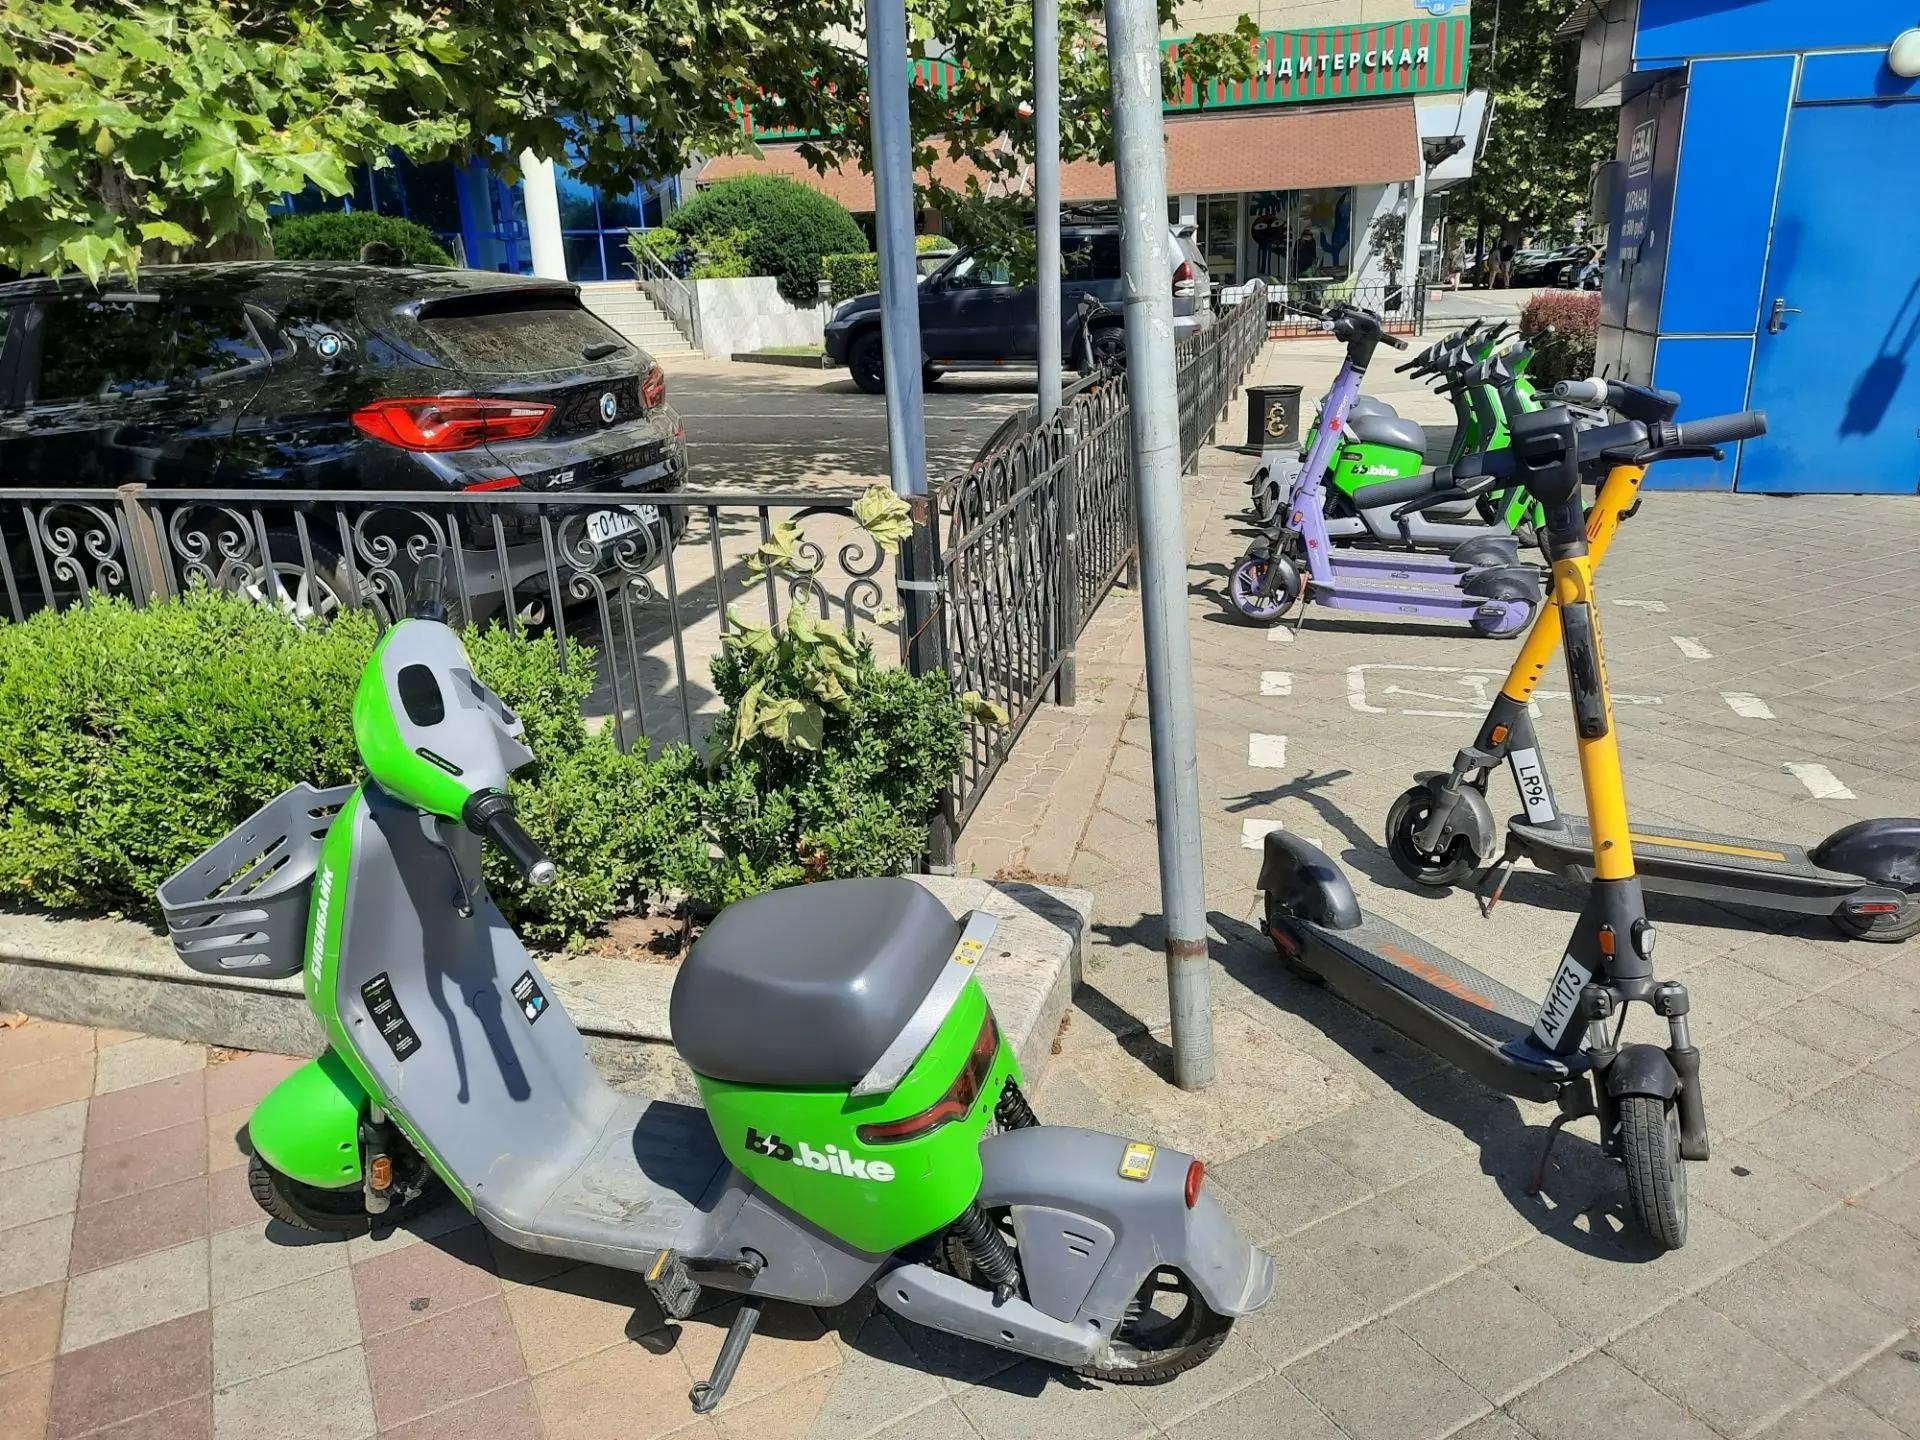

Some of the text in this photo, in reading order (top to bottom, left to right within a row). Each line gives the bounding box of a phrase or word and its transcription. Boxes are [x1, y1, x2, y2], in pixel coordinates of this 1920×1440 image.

[1258, 47, 1429, 79] НДИТЕРСКАЯ
[1519, 765, 1546, 806] LR96
[1540, 966, 1581, 1039] AM1173
